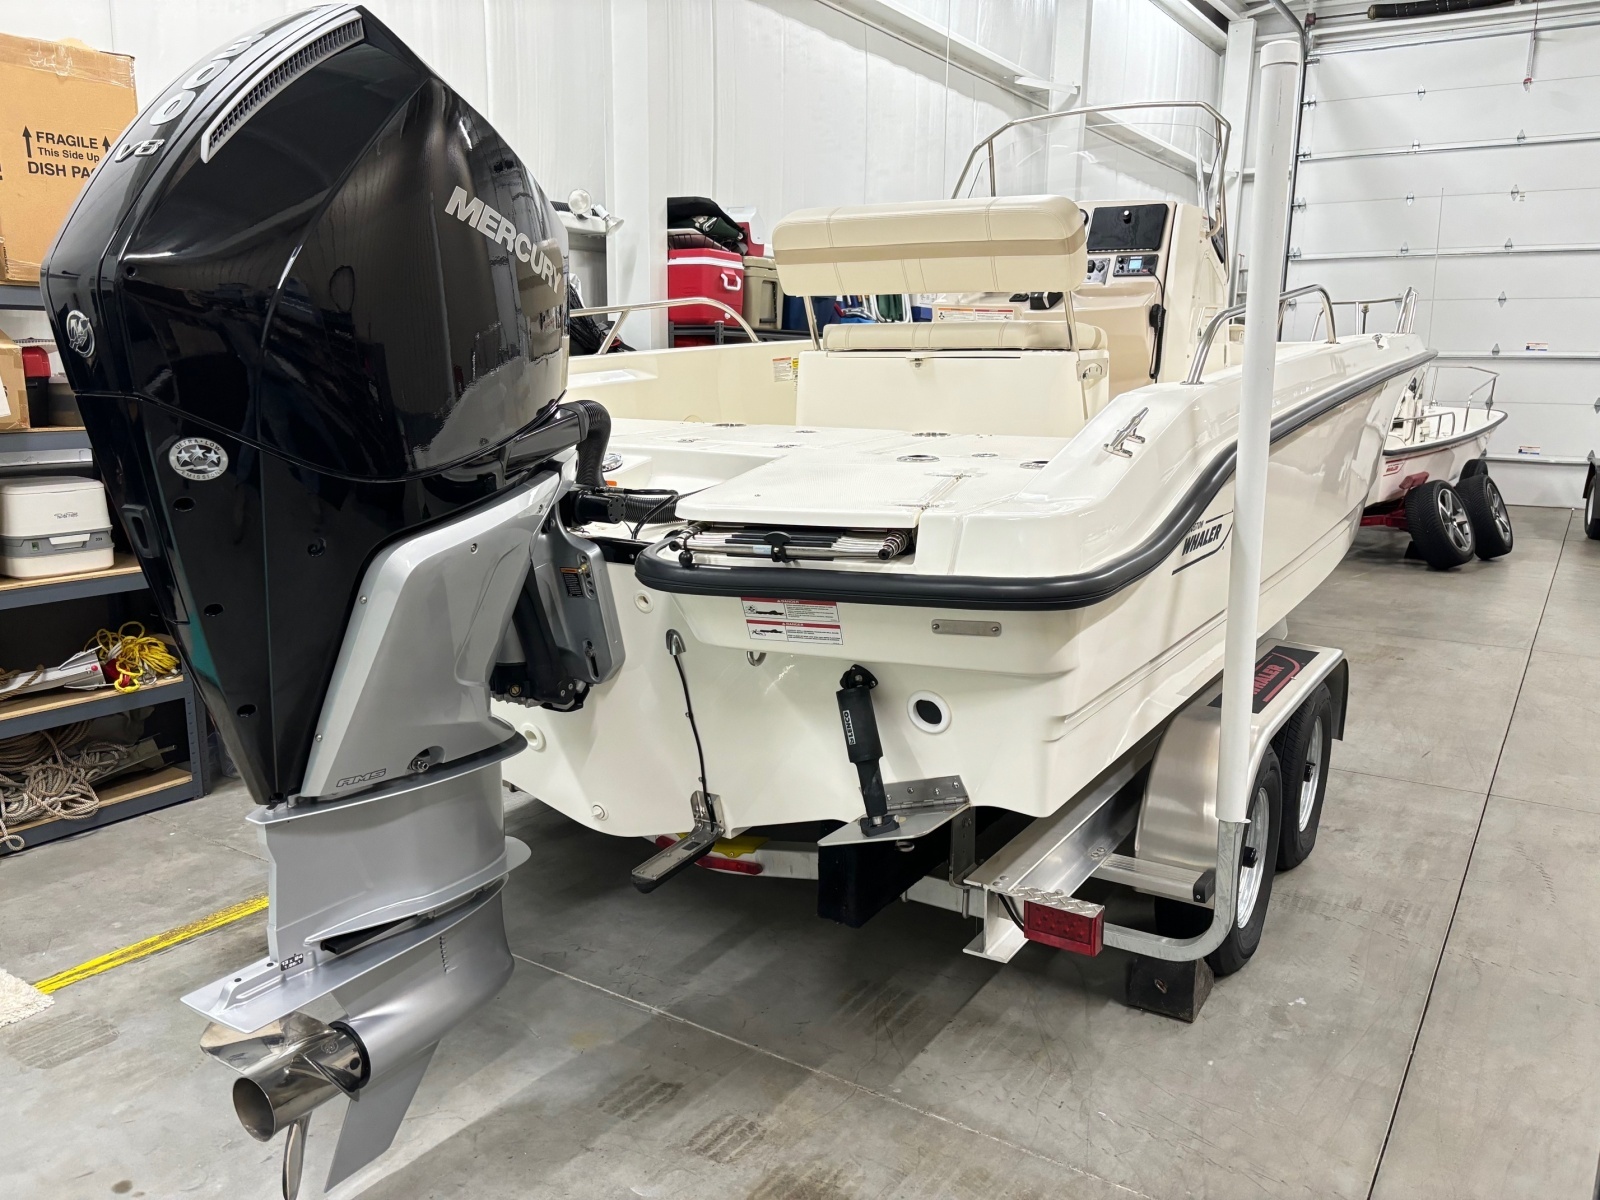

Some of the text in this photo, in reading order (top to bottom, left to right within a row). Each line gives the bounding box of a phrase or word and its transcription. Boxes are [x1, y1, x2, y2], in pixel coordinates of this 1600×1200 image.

[36, 131, 98, 149] FRAGILE
[37, 147, 100, 163] This Side Up
[115, 139, 165, 163] V8
[28, 161, 66, 177] DISH
[444, 185, 562, 294] MERCURY
[175, 438, 221, 452] ULTRA LOW
[1182, 523, 1223, 556] WHALER
[844, 711, 854, 738] LENCO
[336, 768, 386, 787] AMS
